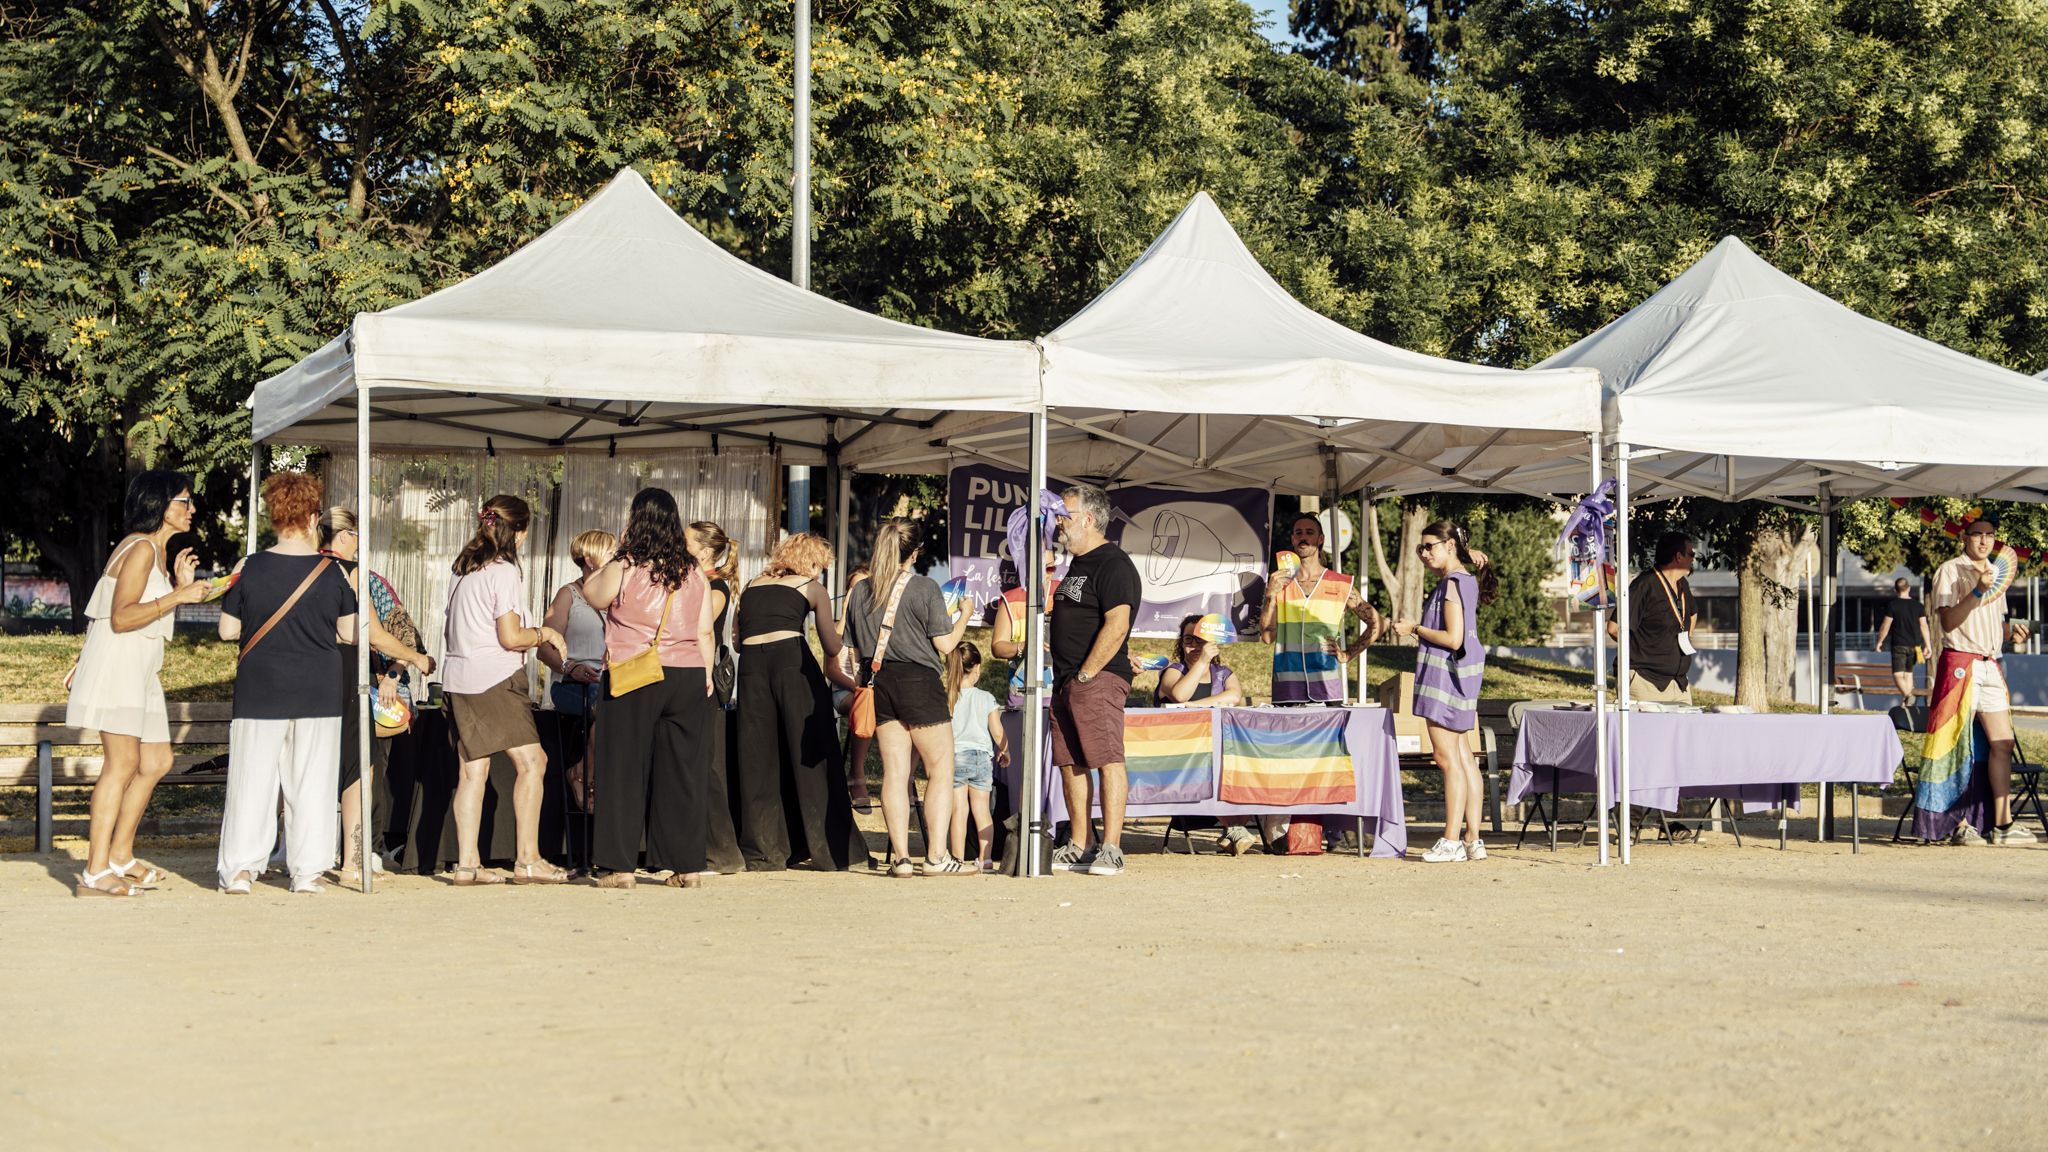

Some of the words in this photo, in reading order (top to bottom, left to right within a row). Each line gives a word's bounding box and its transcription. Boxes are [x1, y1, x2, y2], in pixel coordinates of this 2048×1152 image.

[968, 476, 1029, 506] PUN
[964, 504, 1008, 532] LIL
[963, 564, 984, 582] La
[986, 566, 1018, 588] festa
